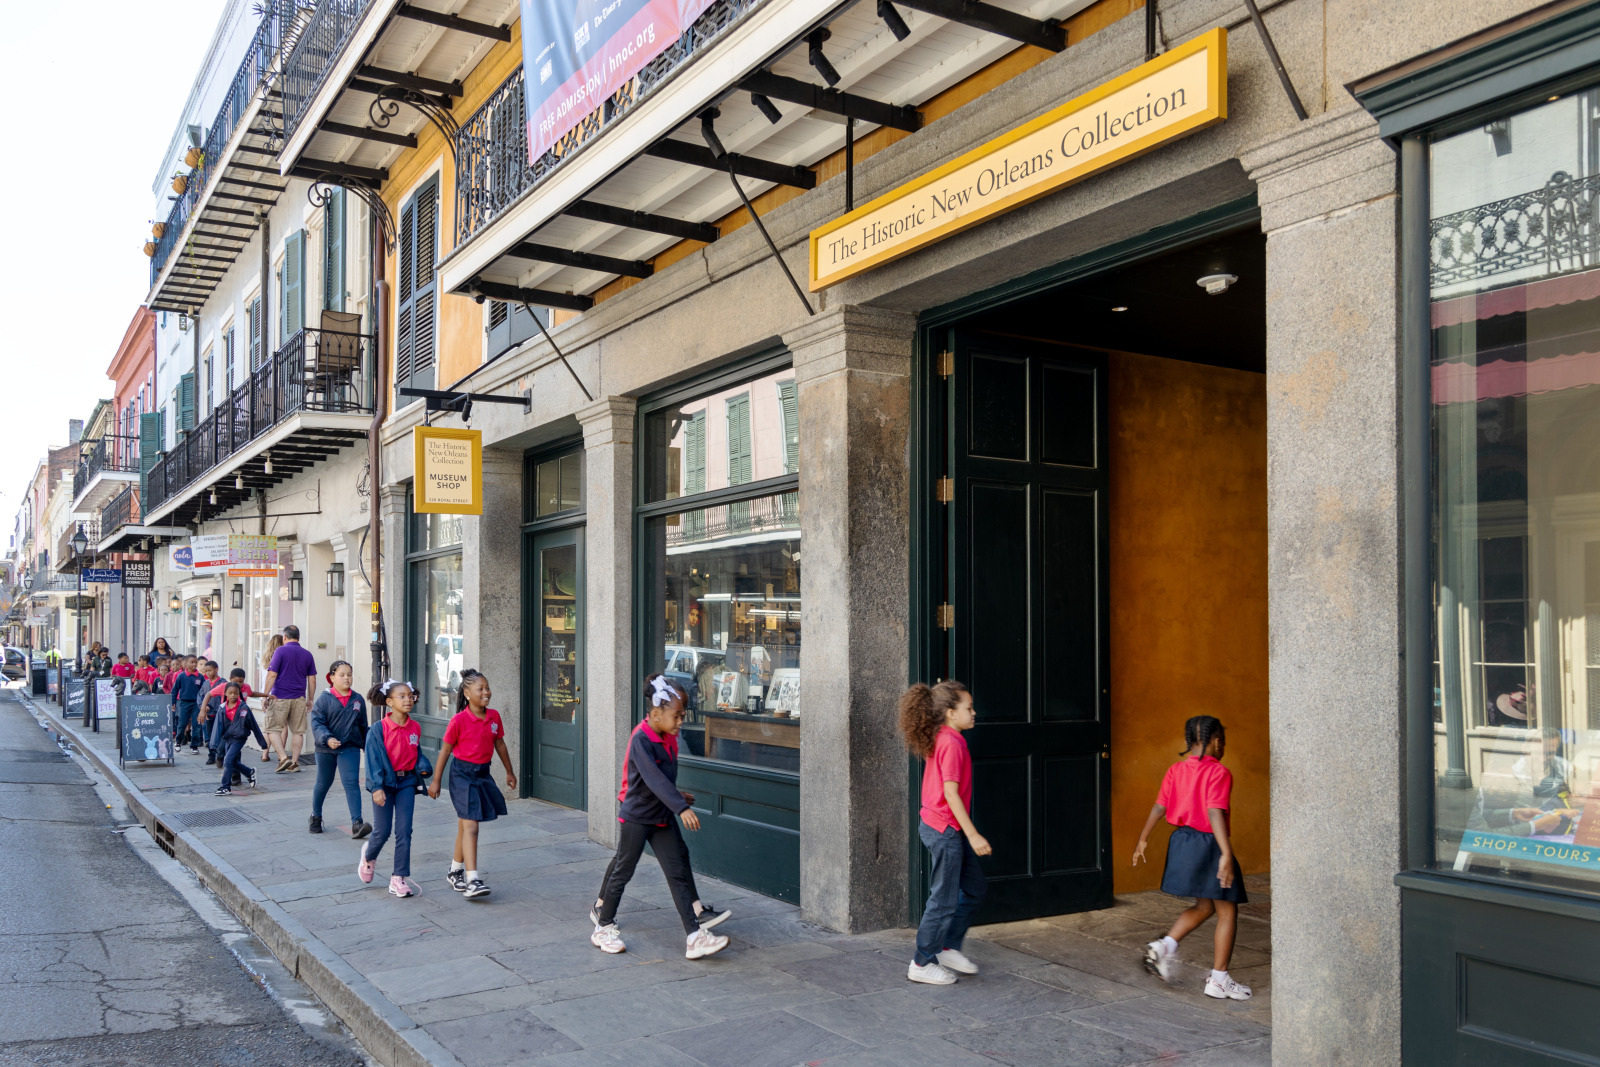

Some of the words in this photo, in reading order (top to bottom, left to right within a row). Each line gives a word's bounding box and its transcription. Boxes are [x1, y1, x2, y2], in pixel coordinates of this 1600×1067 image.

[539, 112, 556, 136] FREE
[557, 73, 601, 120] ADMISSION
[609, 22, 656, 72] hnoc.org
[828, 235, 858, 265] The
[861, 203, 926, 251] Historic
[930, 186, 973, 220] New
[976, 148, 1054, 198] Orleans
[1060, 87, 1188, 158] Collection
[443, 443, 467, 451] Historic
[444, 450, 467, 458] Orleans
[432, 457, 464, 465] Collection
[430, 474, 467, 482] MUSEUM
[239, 538, 268, 548] nola
[238, 549, 269, 560] kids
[551, 649, 564, 657] OPEN
[99, 693, 114, 702] OFF
[1473, 837, 1517, 851] SHOP
[1535, 845, 1591, 862] TOURS
